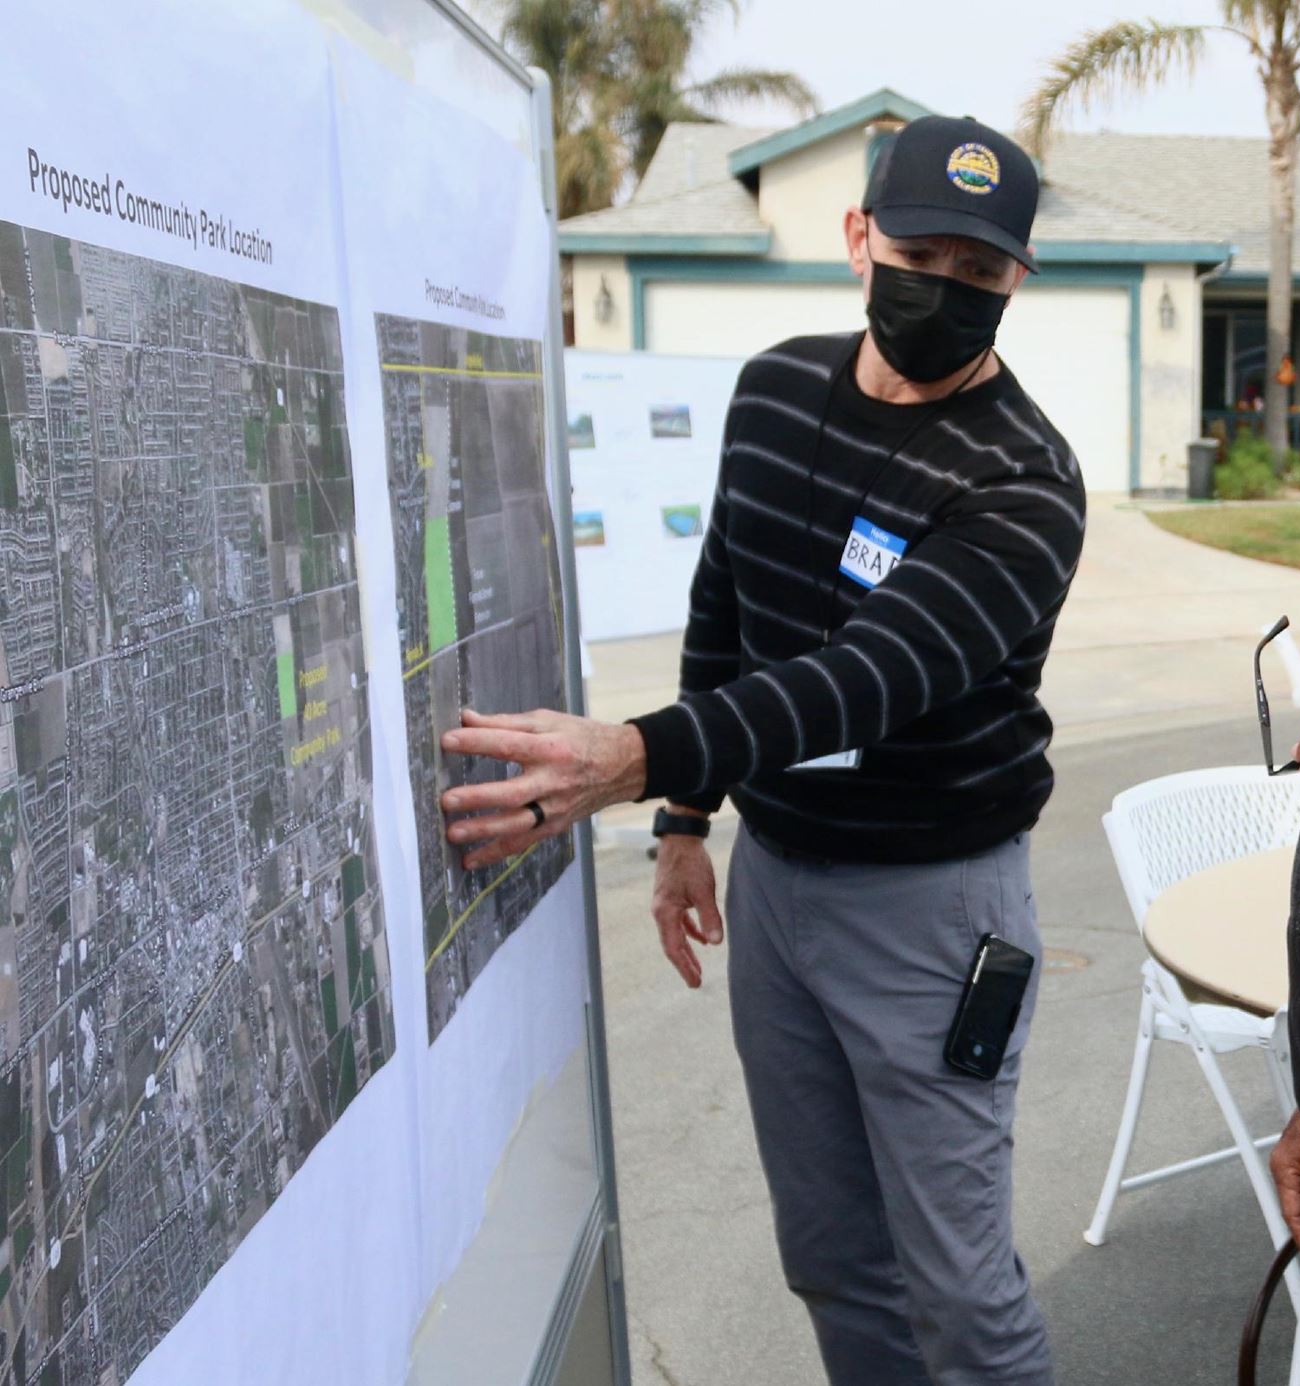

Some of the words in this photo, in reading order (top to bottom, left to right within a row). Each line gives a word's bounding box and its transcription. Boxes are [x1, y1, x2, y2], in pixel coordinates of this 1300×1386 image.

[27, 147, 112, 214] Proposed
[115, 179, 197, 250] Community
[200, 209, 227, 251] Park
[229, 219, 272, 265] Location
